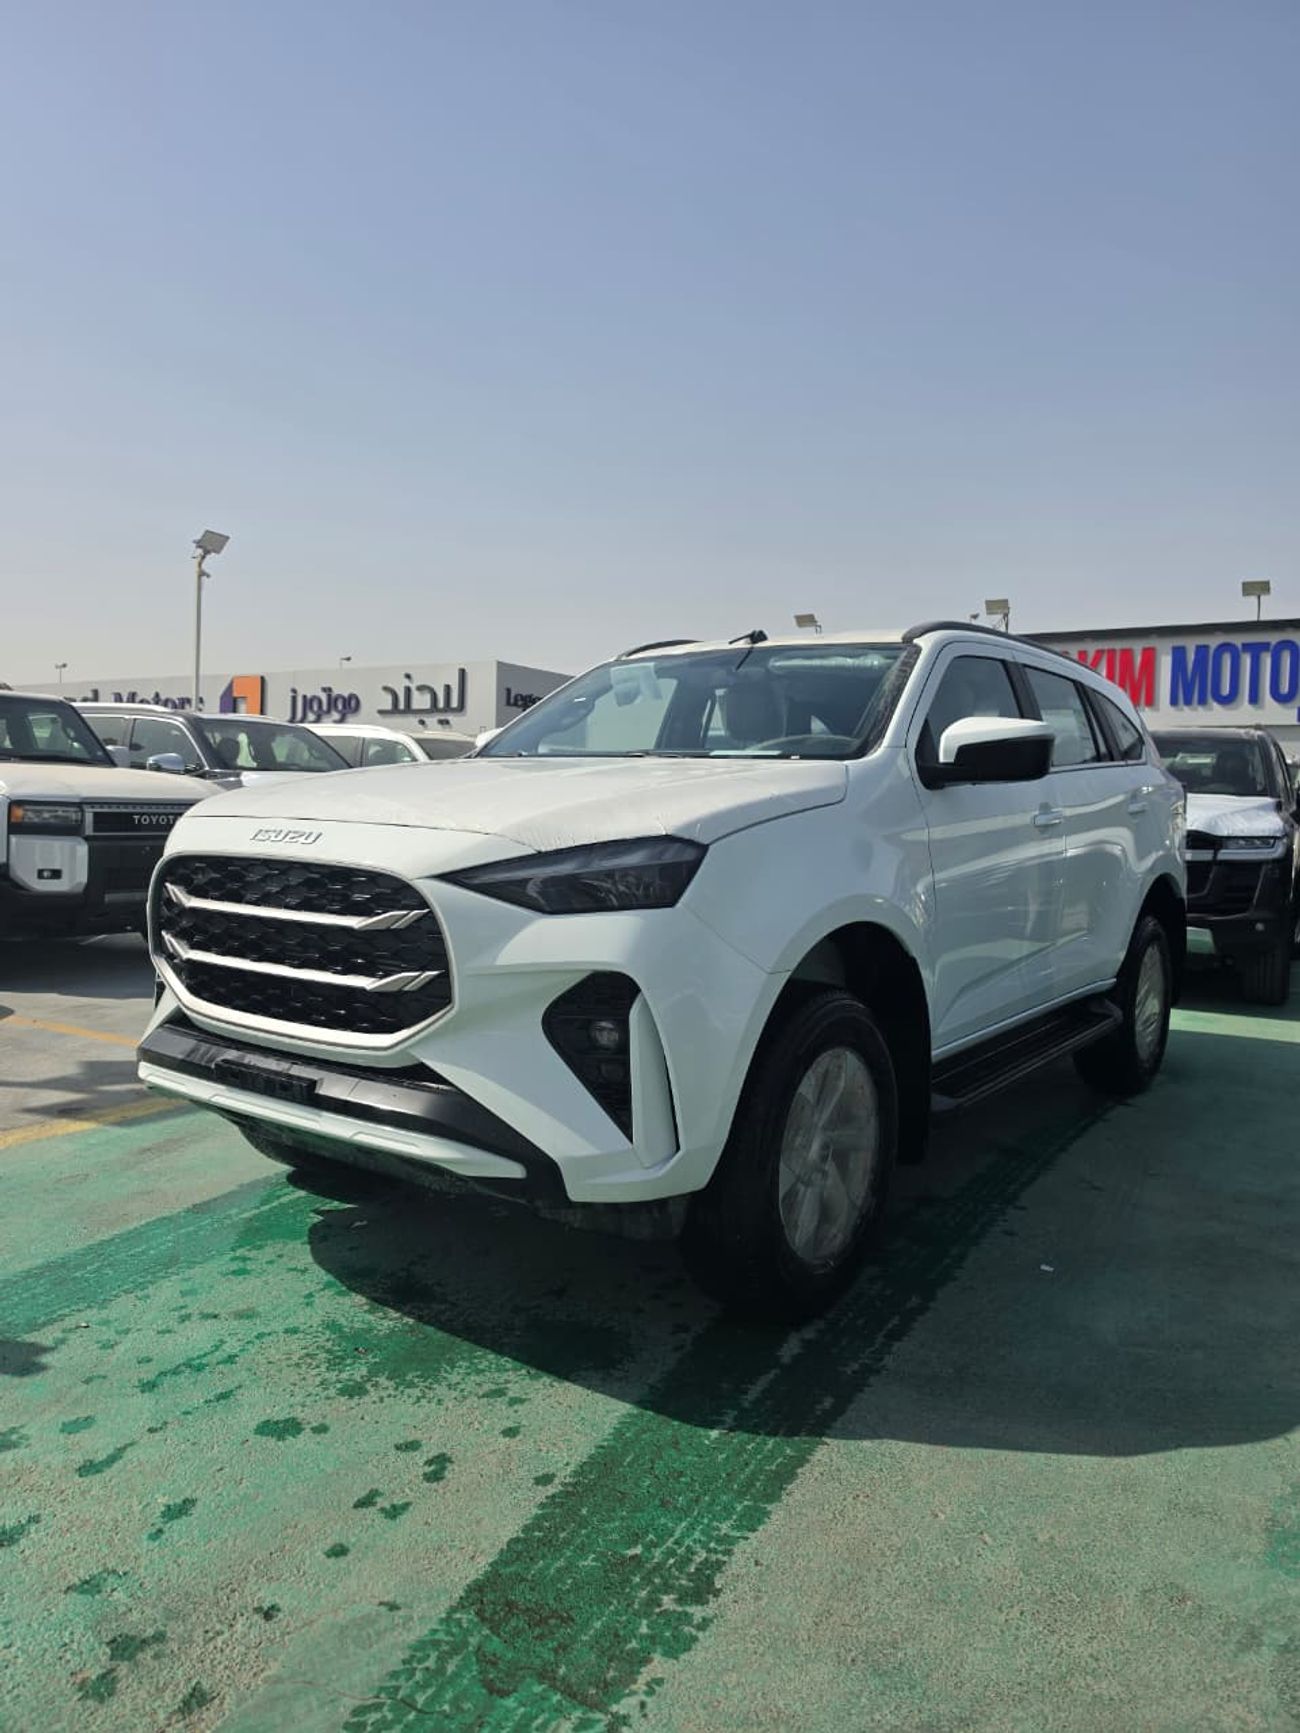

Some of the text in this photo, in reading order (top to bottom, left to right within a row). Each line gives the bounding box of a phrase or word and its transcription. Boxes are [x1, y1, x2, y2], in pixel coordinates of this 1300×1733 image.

[1169, 639, 1299, 706] MOTO
[288, 667, 466, 728] ليجند موتورز
[132, 814, 180, 825] TOYOT
[250, 829, 323, 845] ISUZU
